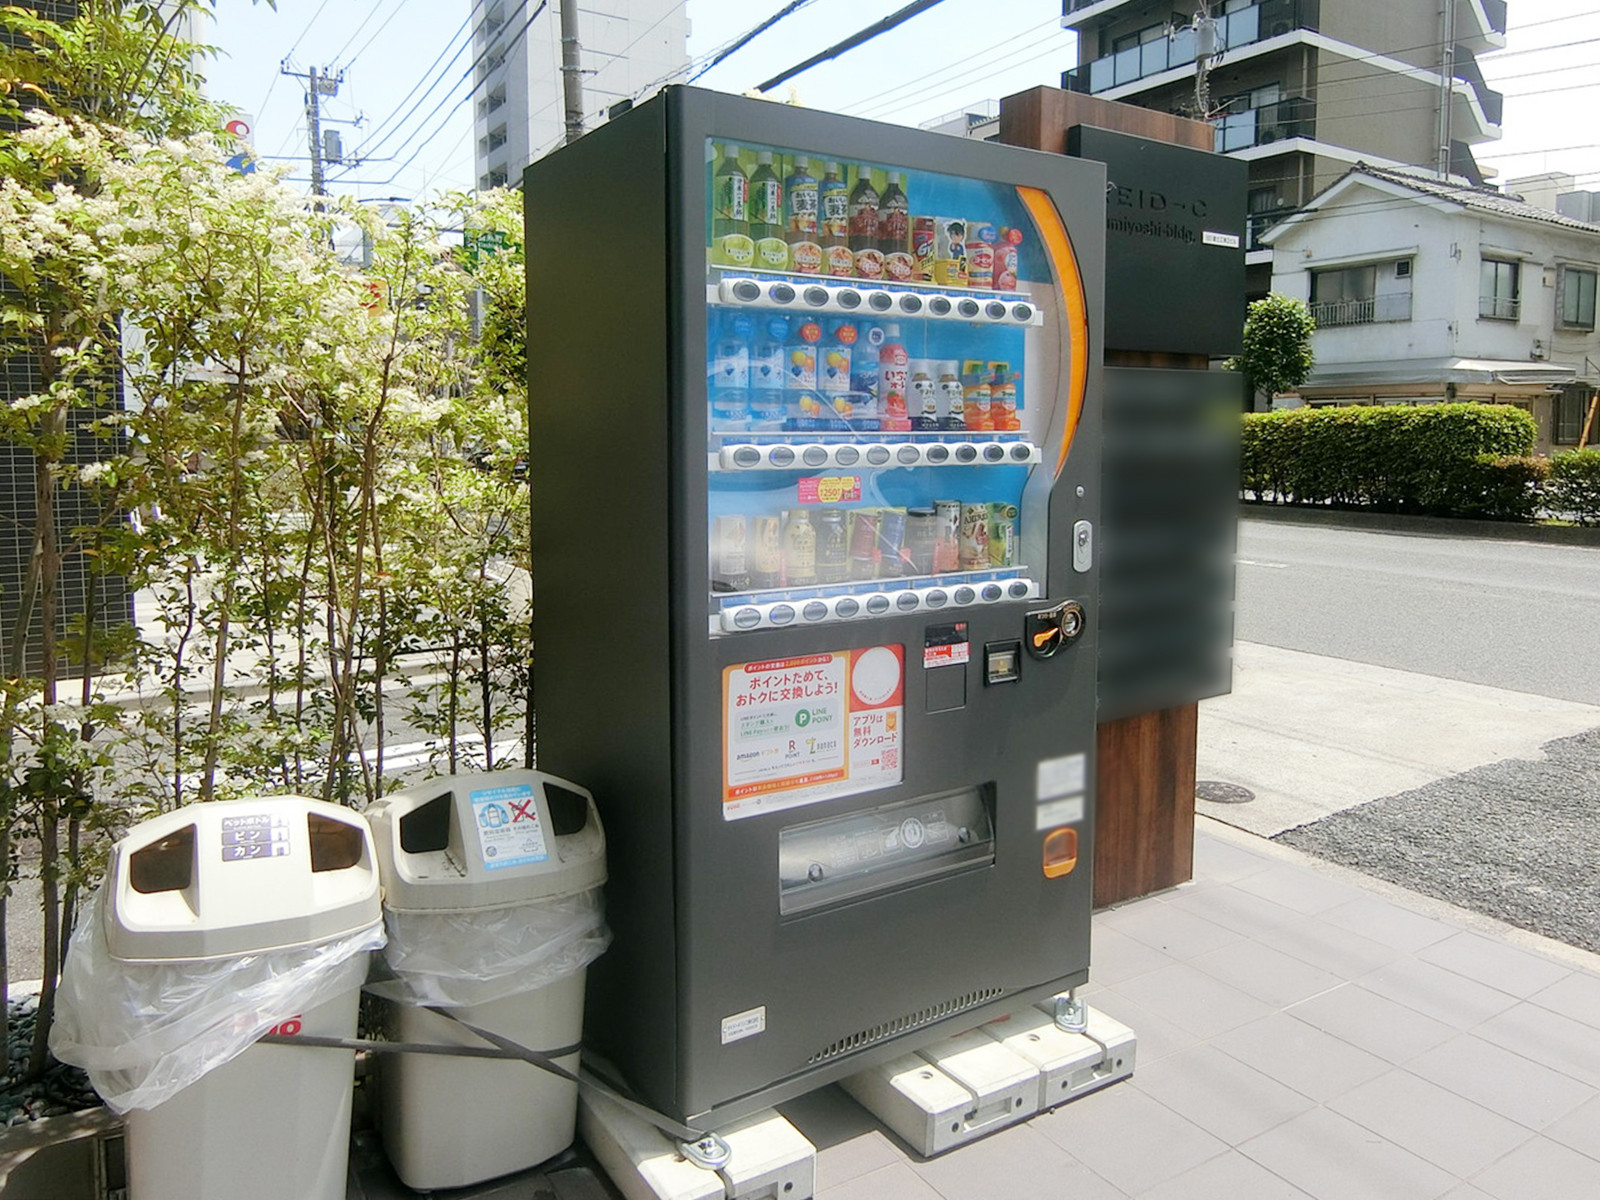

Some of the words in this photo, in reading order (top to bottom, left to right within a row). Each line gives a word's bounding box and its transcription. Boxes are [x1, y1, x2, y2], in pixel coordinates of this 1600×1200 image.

[749, 669, 829, 690] ポイントためて、
[811, 707, 828, 716] LINE
[812, 715, 833, 725] POINT
[853, 714, 883, 727] アプリは
[853, 726, 871, 737] 無料
[853, 731, 898, 749] ダウンロード
[736, 751, 760, 761] amazon
[224, 816, 271, 827] ペットボトル
[235, 830, 261, 841] ビン
[234, 845, 261, 857] カン
